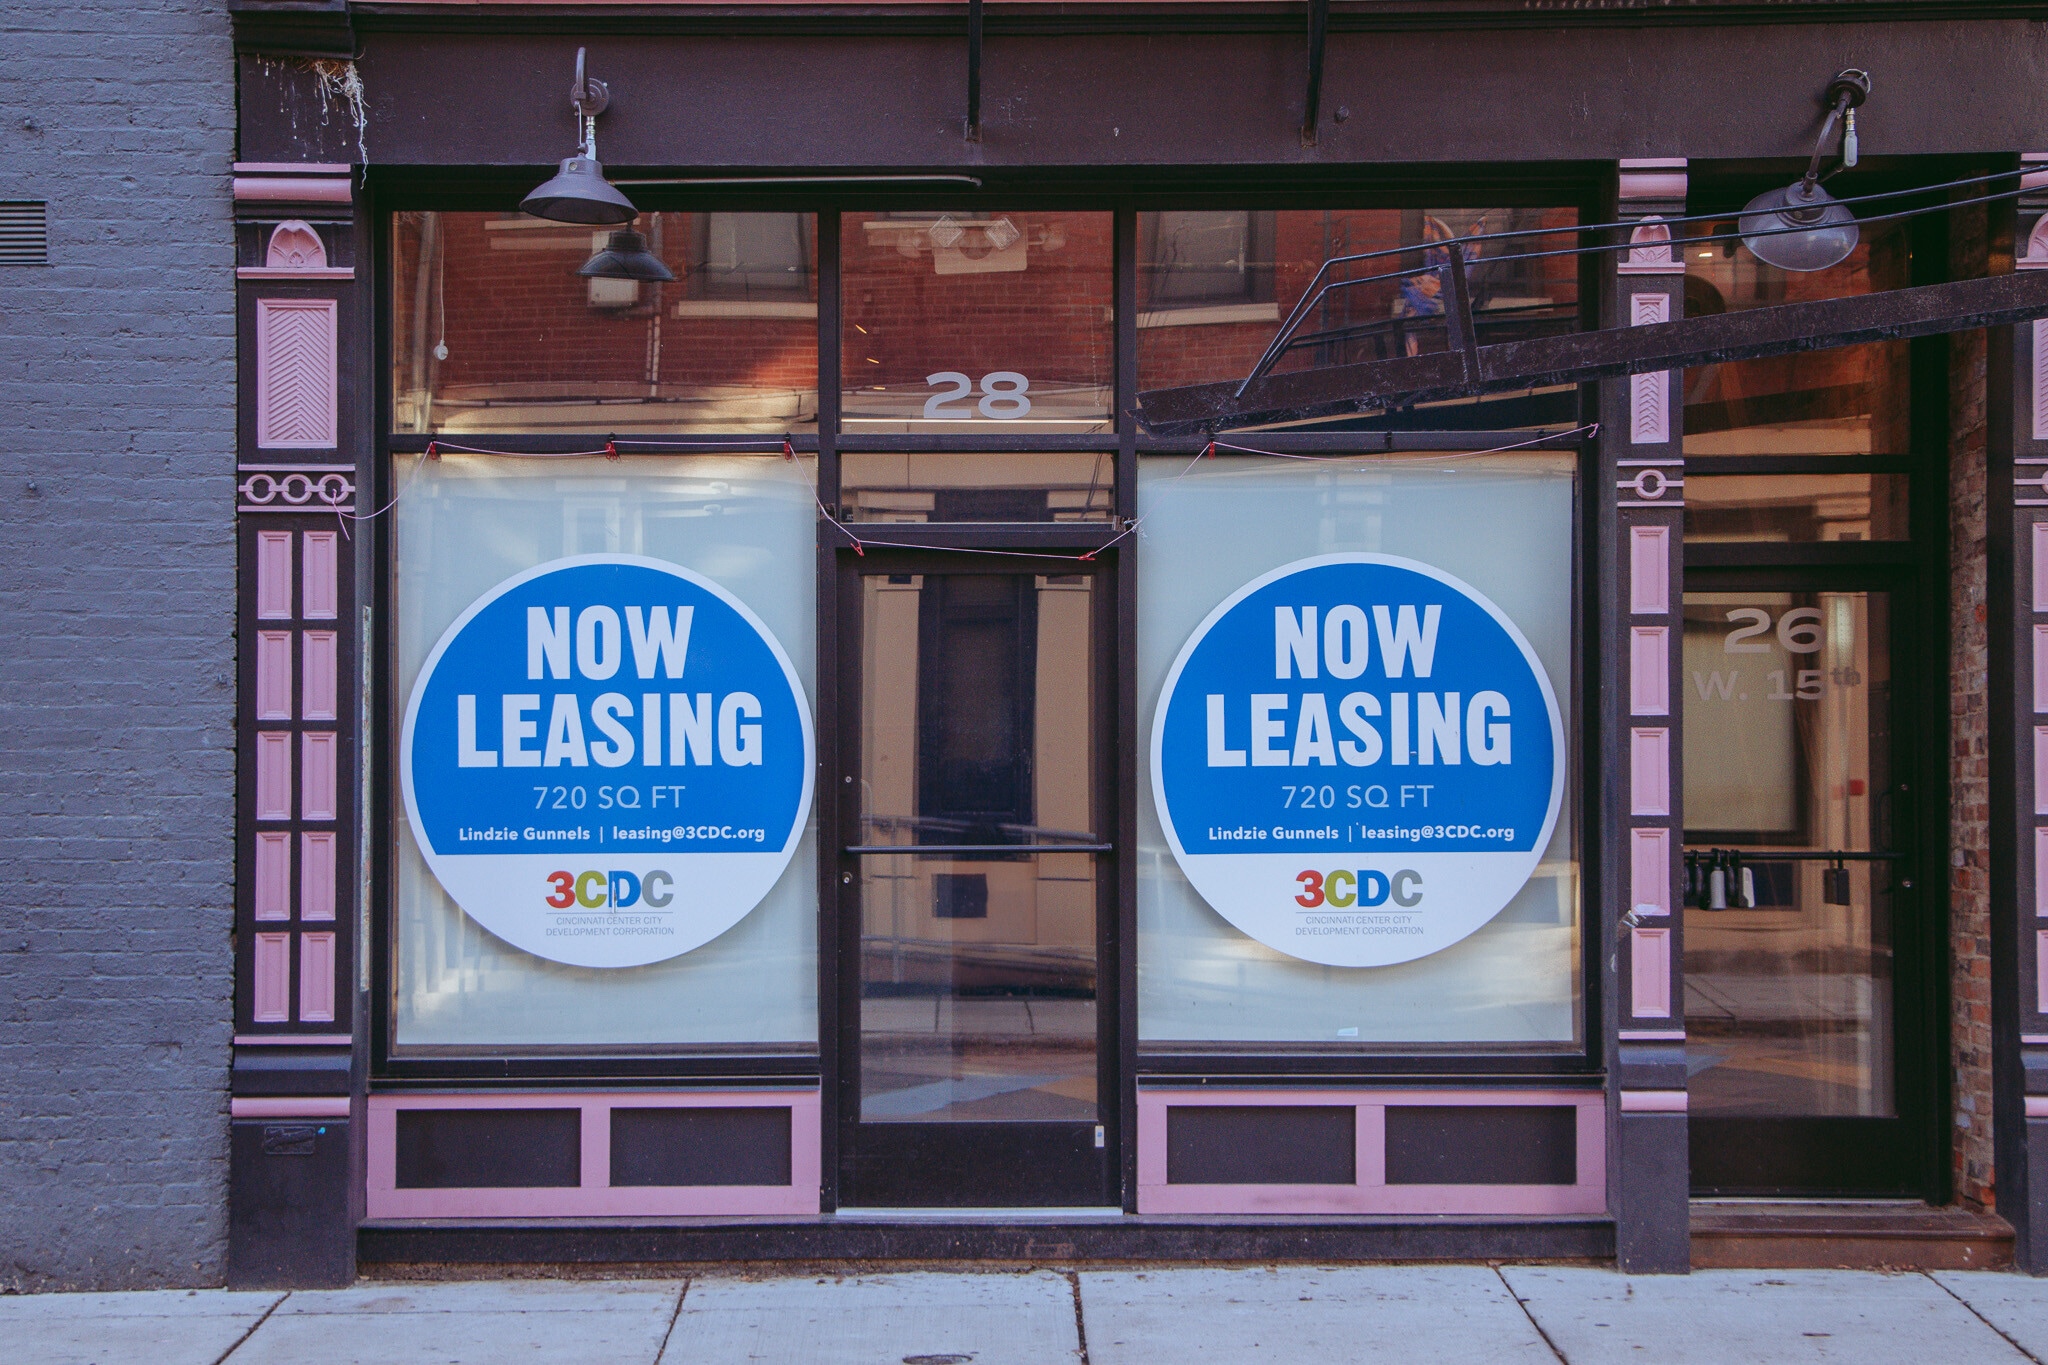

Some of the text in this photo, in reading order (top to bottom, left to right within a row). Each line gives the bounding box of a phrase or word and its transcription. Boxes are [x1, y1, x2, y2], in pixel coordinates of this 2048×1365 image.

[924, 372, 1031, 419] 28
[527, 605, 694, 681] NOW
[1274, 604, 1442, 680] NOW
[1723, 608, 1826, 654] 26
[1692, 670, 1748, 700] W.
[458, 691, 762, 768] LEASING
[1206, 690, 1511, 768] LEASING
[533, 786, 686, 810] 720 SQ FT
[1281, 785, 1435, 809] 720 SQ FT
[459, 826, 518, 841] Lindzie
[523, 826, 590, 841] Gunnels
[613, 826, 765, 842] leasing@3CDC.org
[1208, 826, 1268, 840] Lindzie
[1273, 826, 1339, 840] Gunnels
[1361, 825, 1515, 841] leasing@3CDC.org
[545, 870, 674, 909] 3CDC
[1295, 869, 1423, 908] 3CDC
[546, 927, 675, 936] DEVELOPMENT CORPORATION
[556, 916, 663, 925] CINCINNATI CENTER CITY
[1295, 926, 1424, 935] DEVELOPMENT CORPORATION
[1305, 915, 1412, 925] CINCINNATI CENTER CITY
